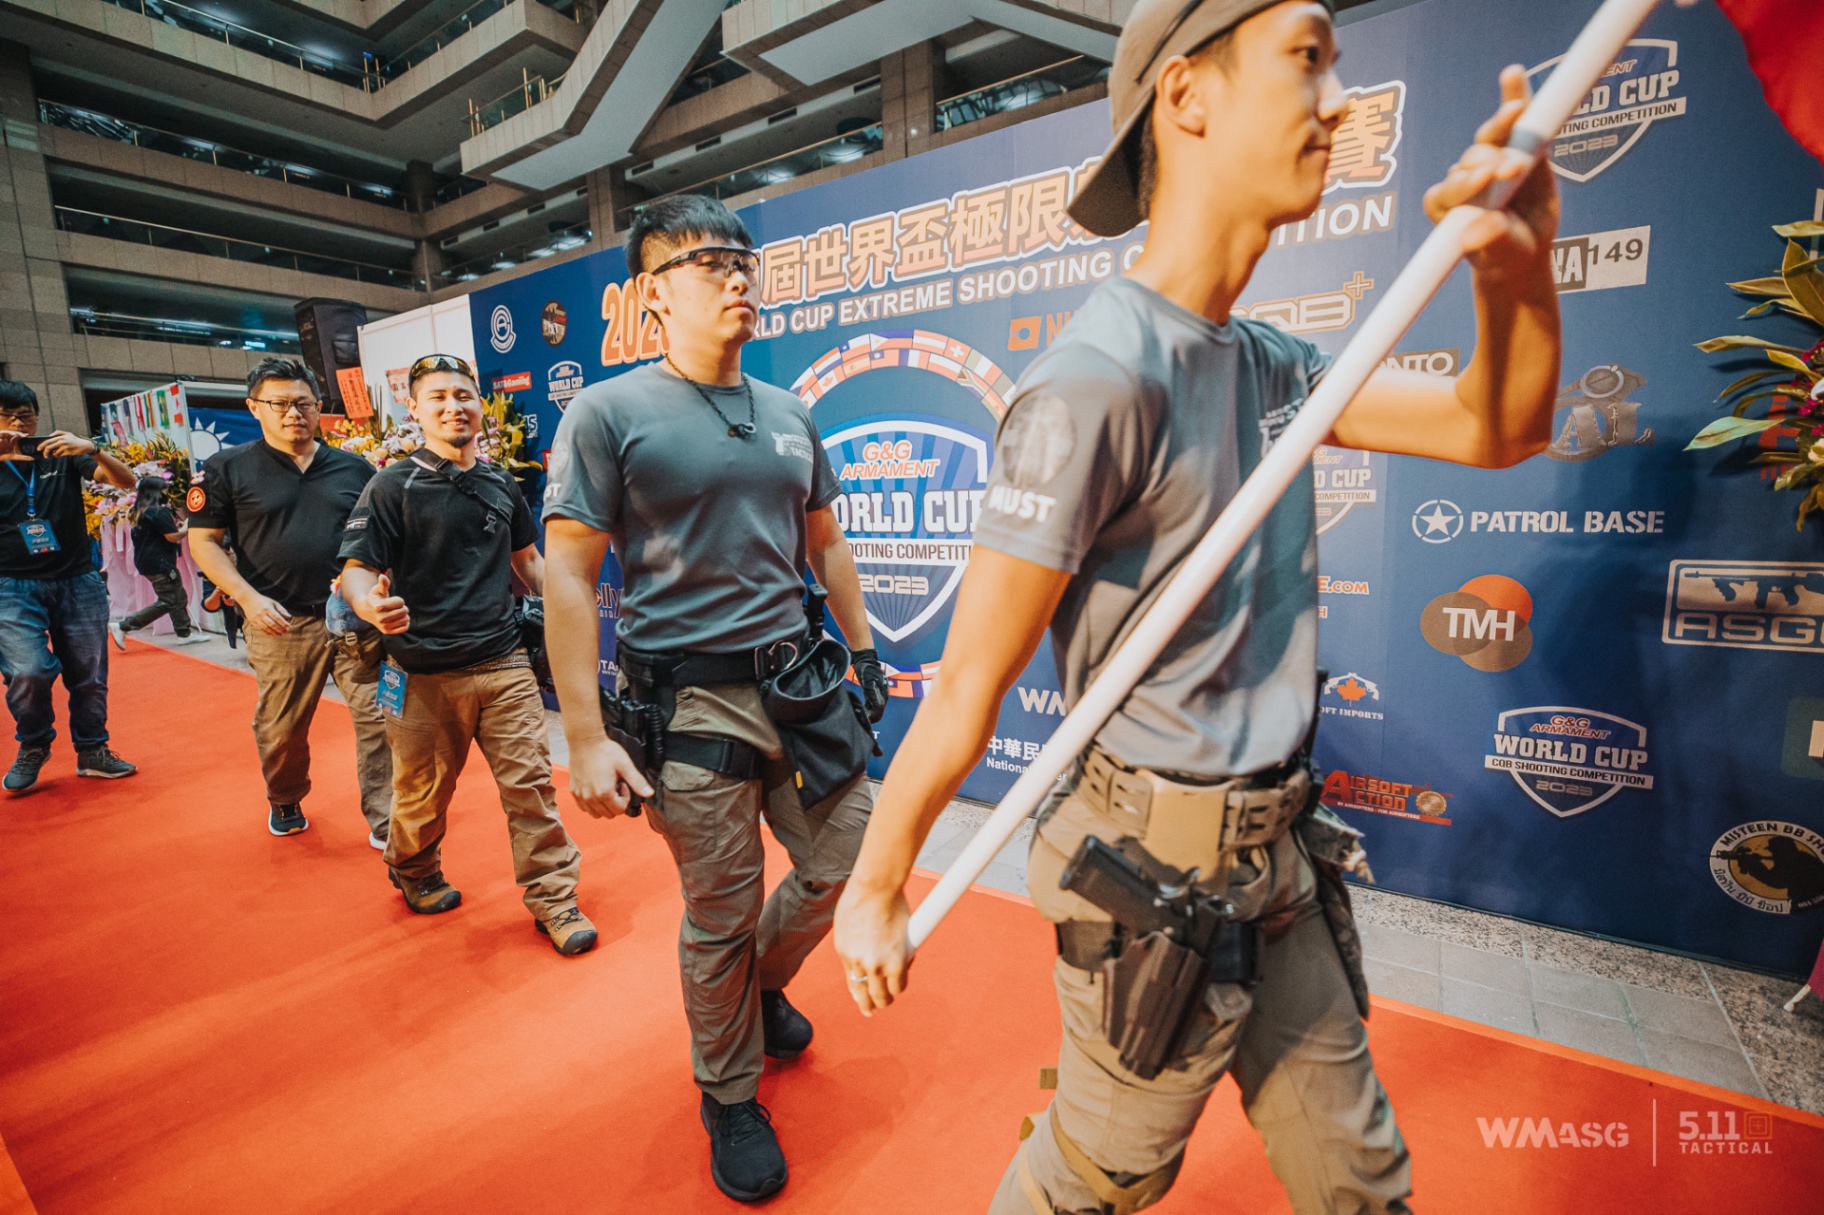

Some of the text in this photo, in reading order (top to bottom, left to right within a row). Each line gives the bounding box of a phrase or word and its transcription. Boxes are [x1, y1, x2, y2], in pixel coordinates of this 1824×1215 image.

[1619, 70, 1680, 106] CUP
[1591, 101, 1678, 128] COMPETITION
[1553, 134, 1618, 157] 2023
[790, 304, 834, 332] CUP
[840, 280, 952, 324] EXTREME
[959, 251, 1112, 302] SHOOTING
[863, 440, 912, 462] G&G
[839, 459, 940, 481] ARMAMENT
[1331, 468, 1372, 488] CUP
[988, 485, 1057, 523] MUST
[1315, 492, 1370, 500] COMPETITION
[1469, 510, 1665, 534] PATROL BASE
[858, 573, 929, 596] 2023
[1443, 607, 1516, 642] TMH
[1675, 612, 1824, 645] ASG
[1339, 708, 1384, 720] IMPORTS
[1550, 715, 1591, 729] G&G
[1529, 723, 1612, 740] ARMAMENT
[1493, 733, 1649, 771] WORLD CUP
[1514, 761, 1568, 776] SHOOTING
[1569, 768, 1646, 786] COMPETITION
[1535, 780, 1593, 797] 2023
[1389, 810, 1421, 820] AIRSOFTERS
[1719, 822, 1778, 847] MISTEEN
[1782, 824, 1806, 838] BB
